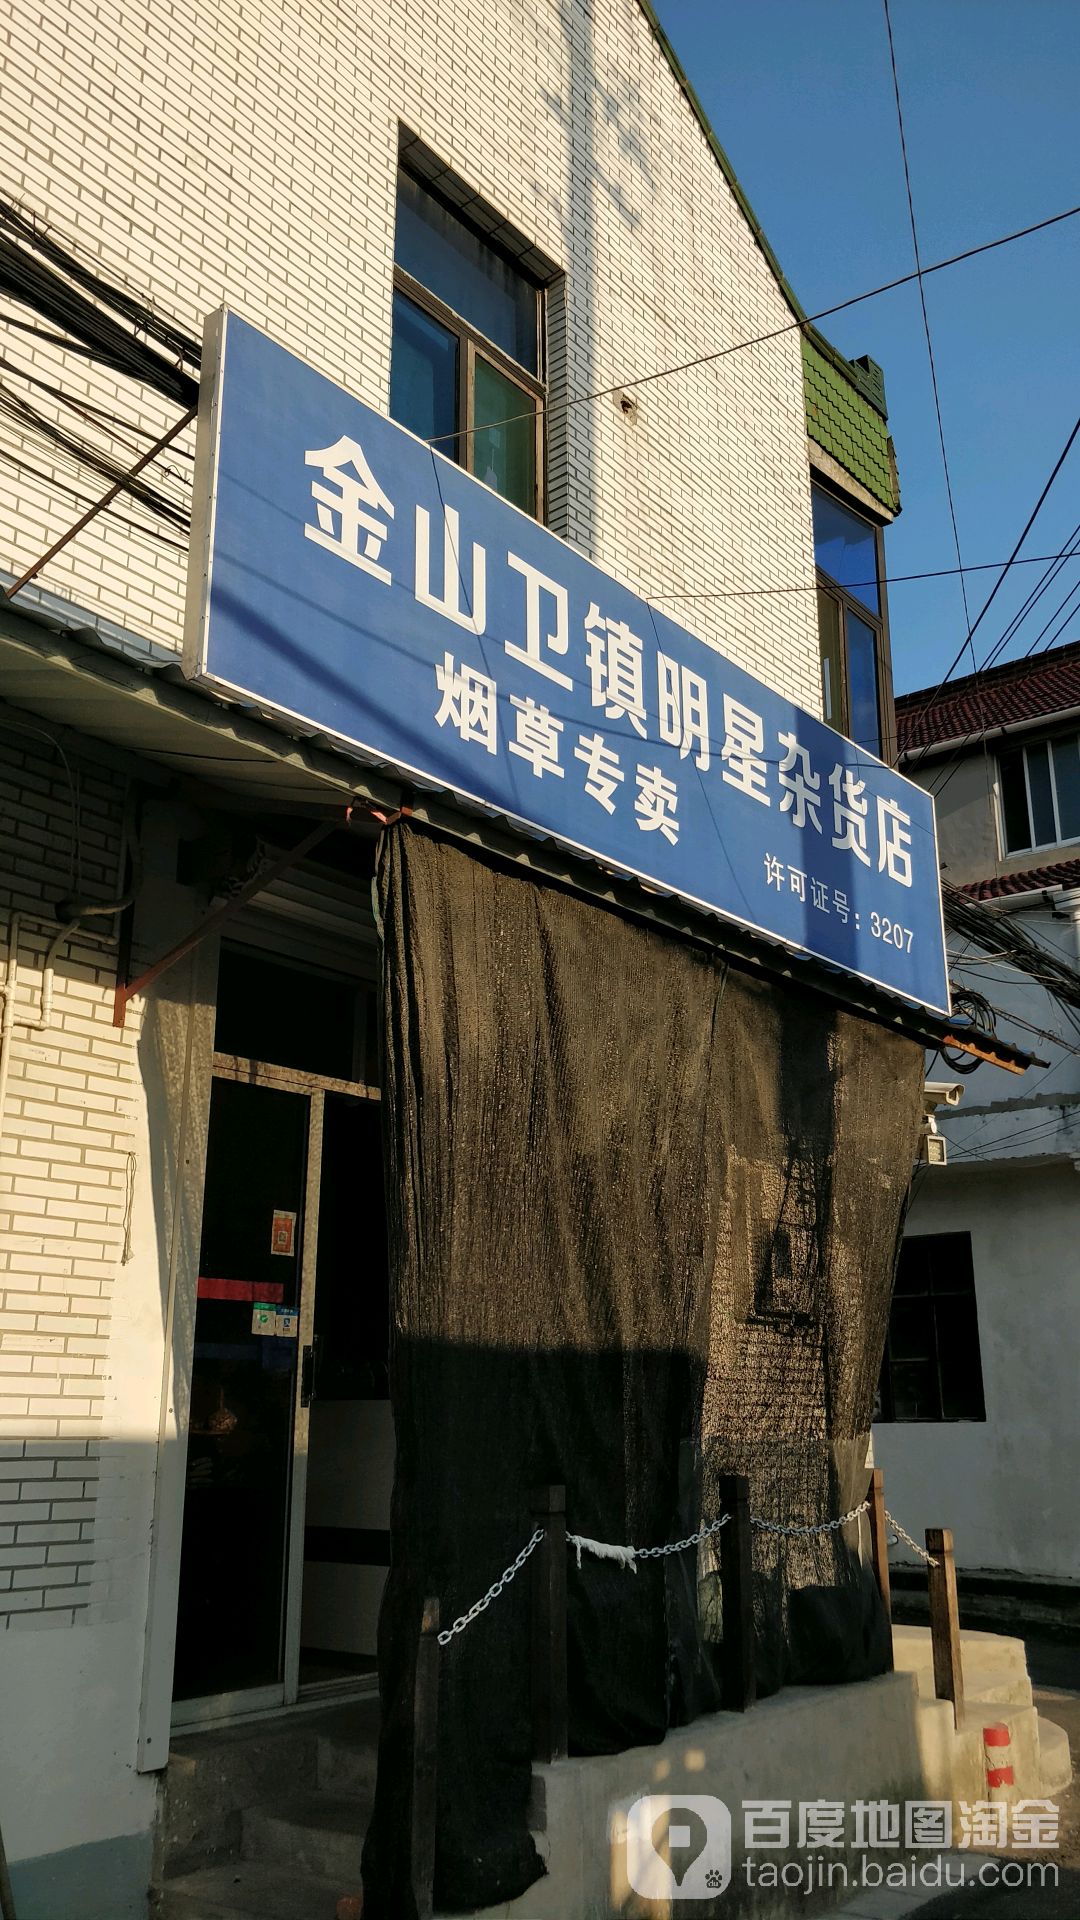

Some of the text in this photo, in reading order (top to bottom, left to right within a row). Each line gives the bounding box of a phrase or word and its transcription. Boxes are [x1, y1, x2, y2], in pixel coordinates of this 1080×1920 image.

[304, 435, 914, 888] 金山卫镇明星杂货店
[433, 652, 681, 845] 烟草专卖
